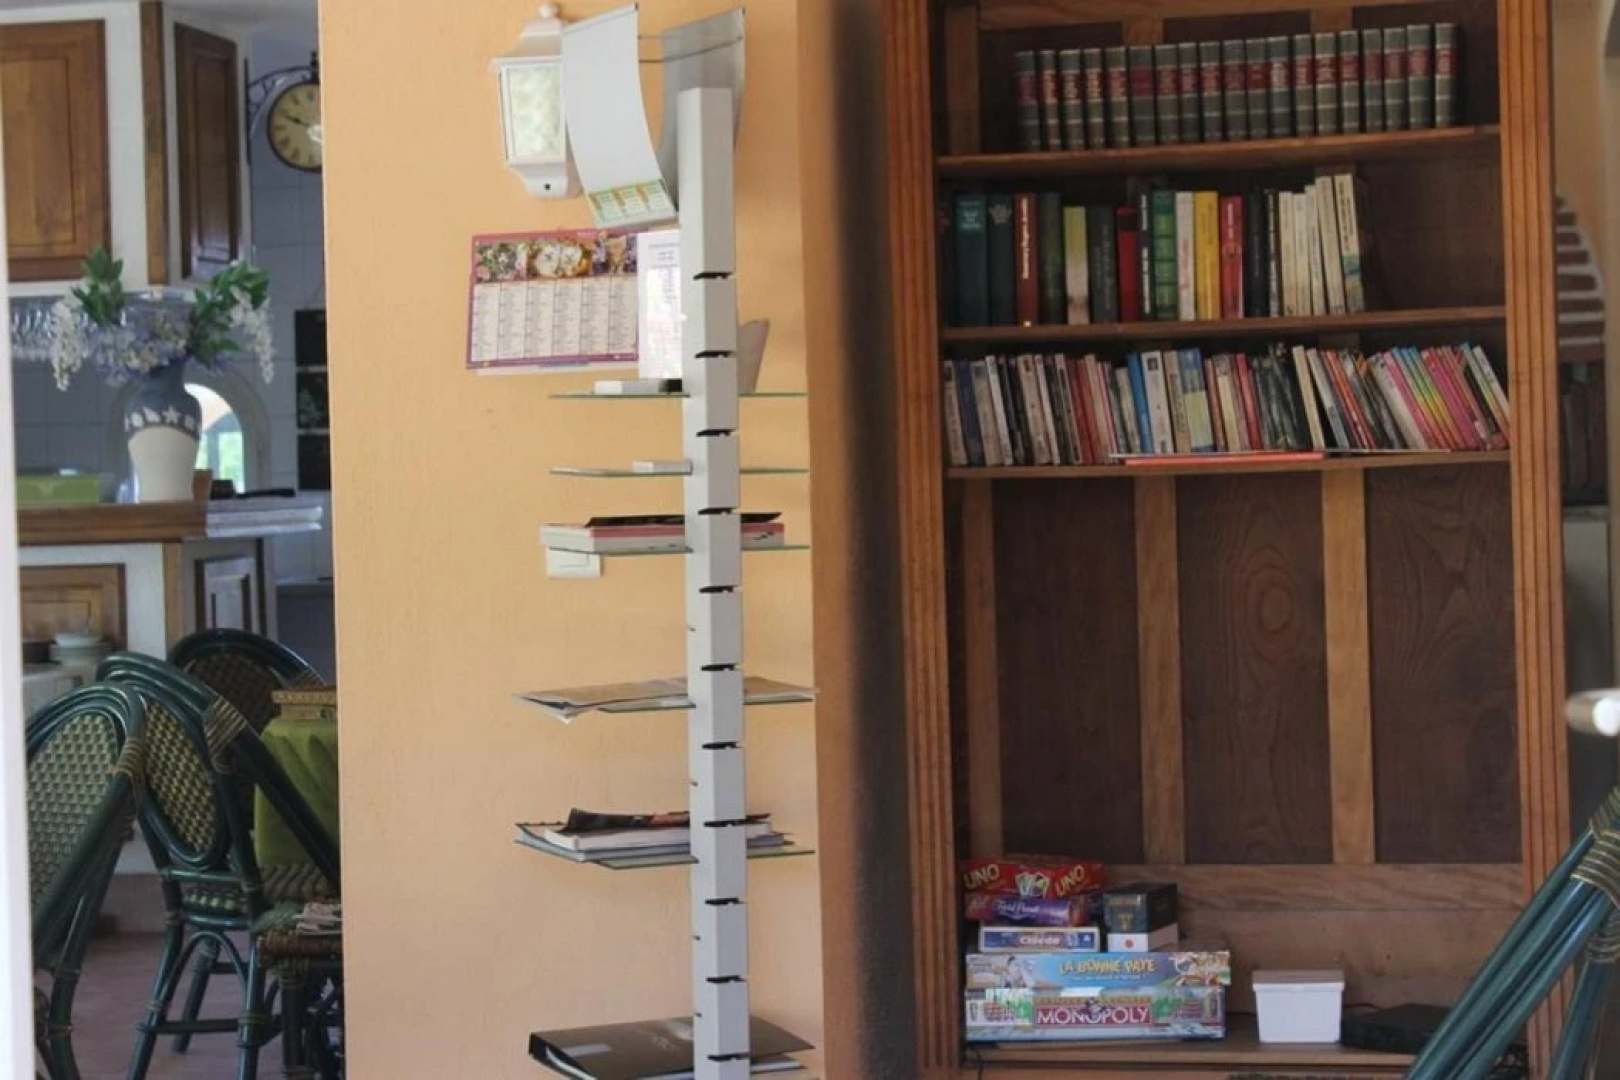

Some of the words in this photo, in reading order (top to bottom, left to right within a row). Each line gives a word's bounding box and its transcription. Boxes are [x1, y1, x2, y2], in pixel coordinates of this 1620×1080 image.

[964, 863, 999, 888] UNO
[1055, 864, 1085, 896] UNO
[1060, 960, 1073, 974] LA
[1077, 958, 1121, 973] BONNE
[1036, 1005, 1150, 1025] MONOPOLY
